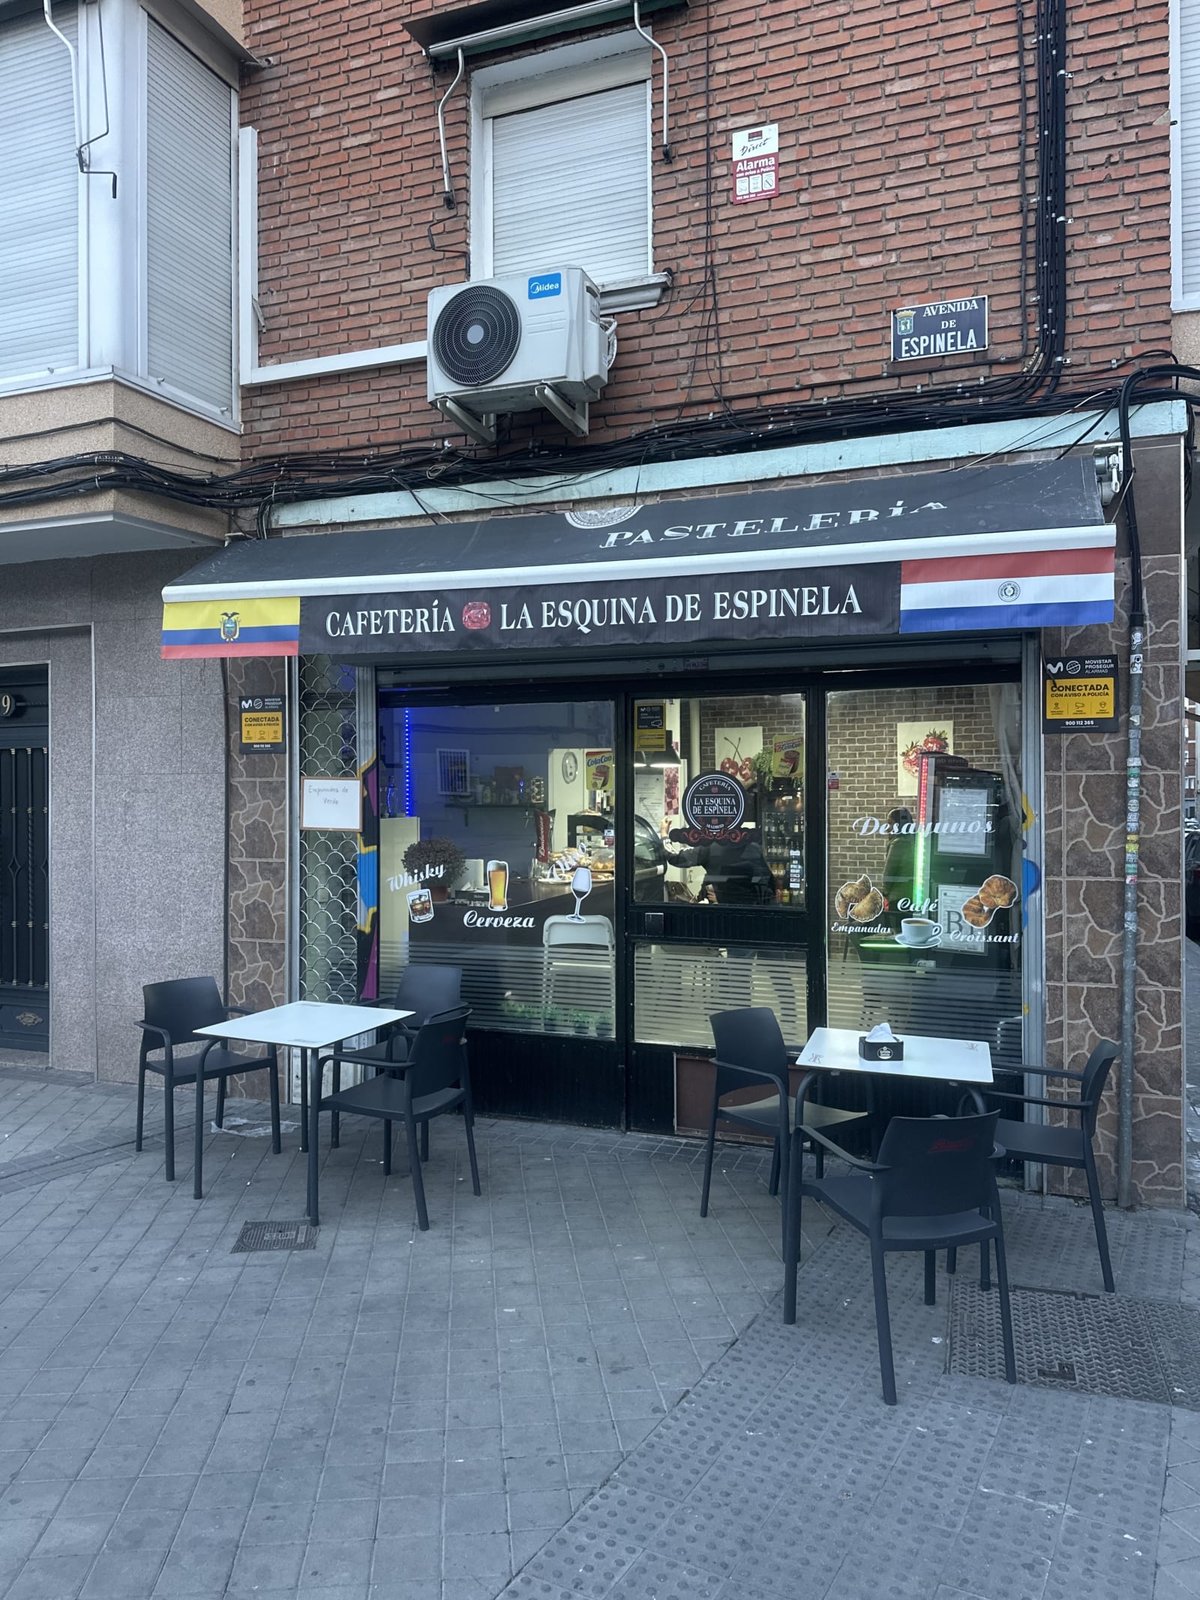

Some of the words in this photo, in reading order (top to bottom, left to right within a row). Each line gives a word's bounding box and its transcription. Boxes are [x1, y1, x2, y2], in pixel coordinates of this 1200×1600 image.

[736, 157, 775, 174] Alarma
[922, 300, 979, 317] AVENIDA
[941, 320, 957, 329] DE
[901, 328, 977, 358] ESPINELA
[326, 599, 455, 637] CAFETERÍA
[500, 603, 534, 630] LA
[541, 596, 658, 634] ESQUINA
[665, 594, 702, 623] DE
[713, 584, 862, 621] ESPINELA
[1050, 684, 1110, 693] CONECTADA
[2, 694, 11, 716] 9
[699, 780, 731, 791] CAFETERÍA
[694, 797, 704, 806] LA
[705, 797, 736, 807] ESQUINA
[692, 806, 702, 815] DE
[704, 806, 738, 815] ESPINELA
[852, 816, 996, 838] Desayunos
[386, 862, 447, 893] Whisky
[897, 898, 938, 914] Café
[463, 910, 537, 928] Cerveza
[830, 922, 891, 934] Empanadas
[950, 930, 1019, 944] Croissant
